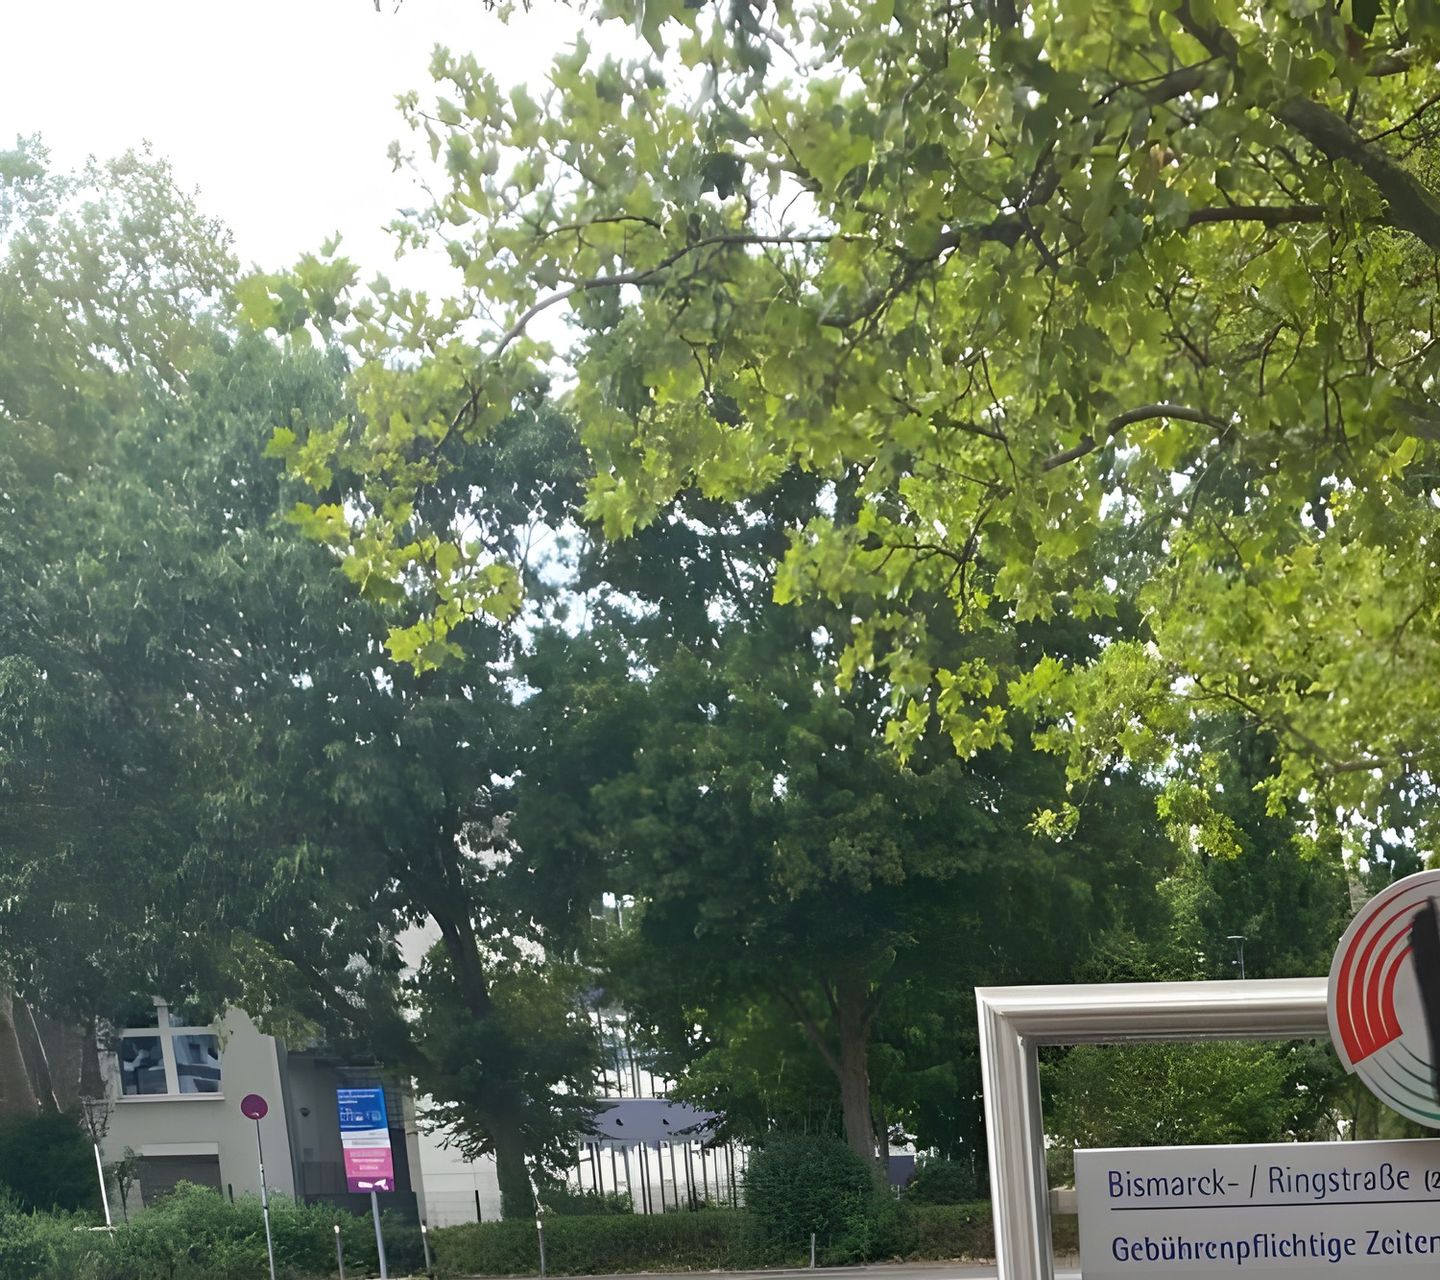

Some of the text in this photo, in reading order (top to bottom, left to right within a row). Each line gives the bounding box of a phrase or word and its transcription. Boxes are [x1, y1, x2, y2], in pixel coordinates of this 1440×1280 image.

[1108, 1167, 1239, 1198] Bismarck-
[1269, 1162, 1410, 1200] Ringstraße
[1111, 1231, 1357, 1266] Gebührenpflichtige
